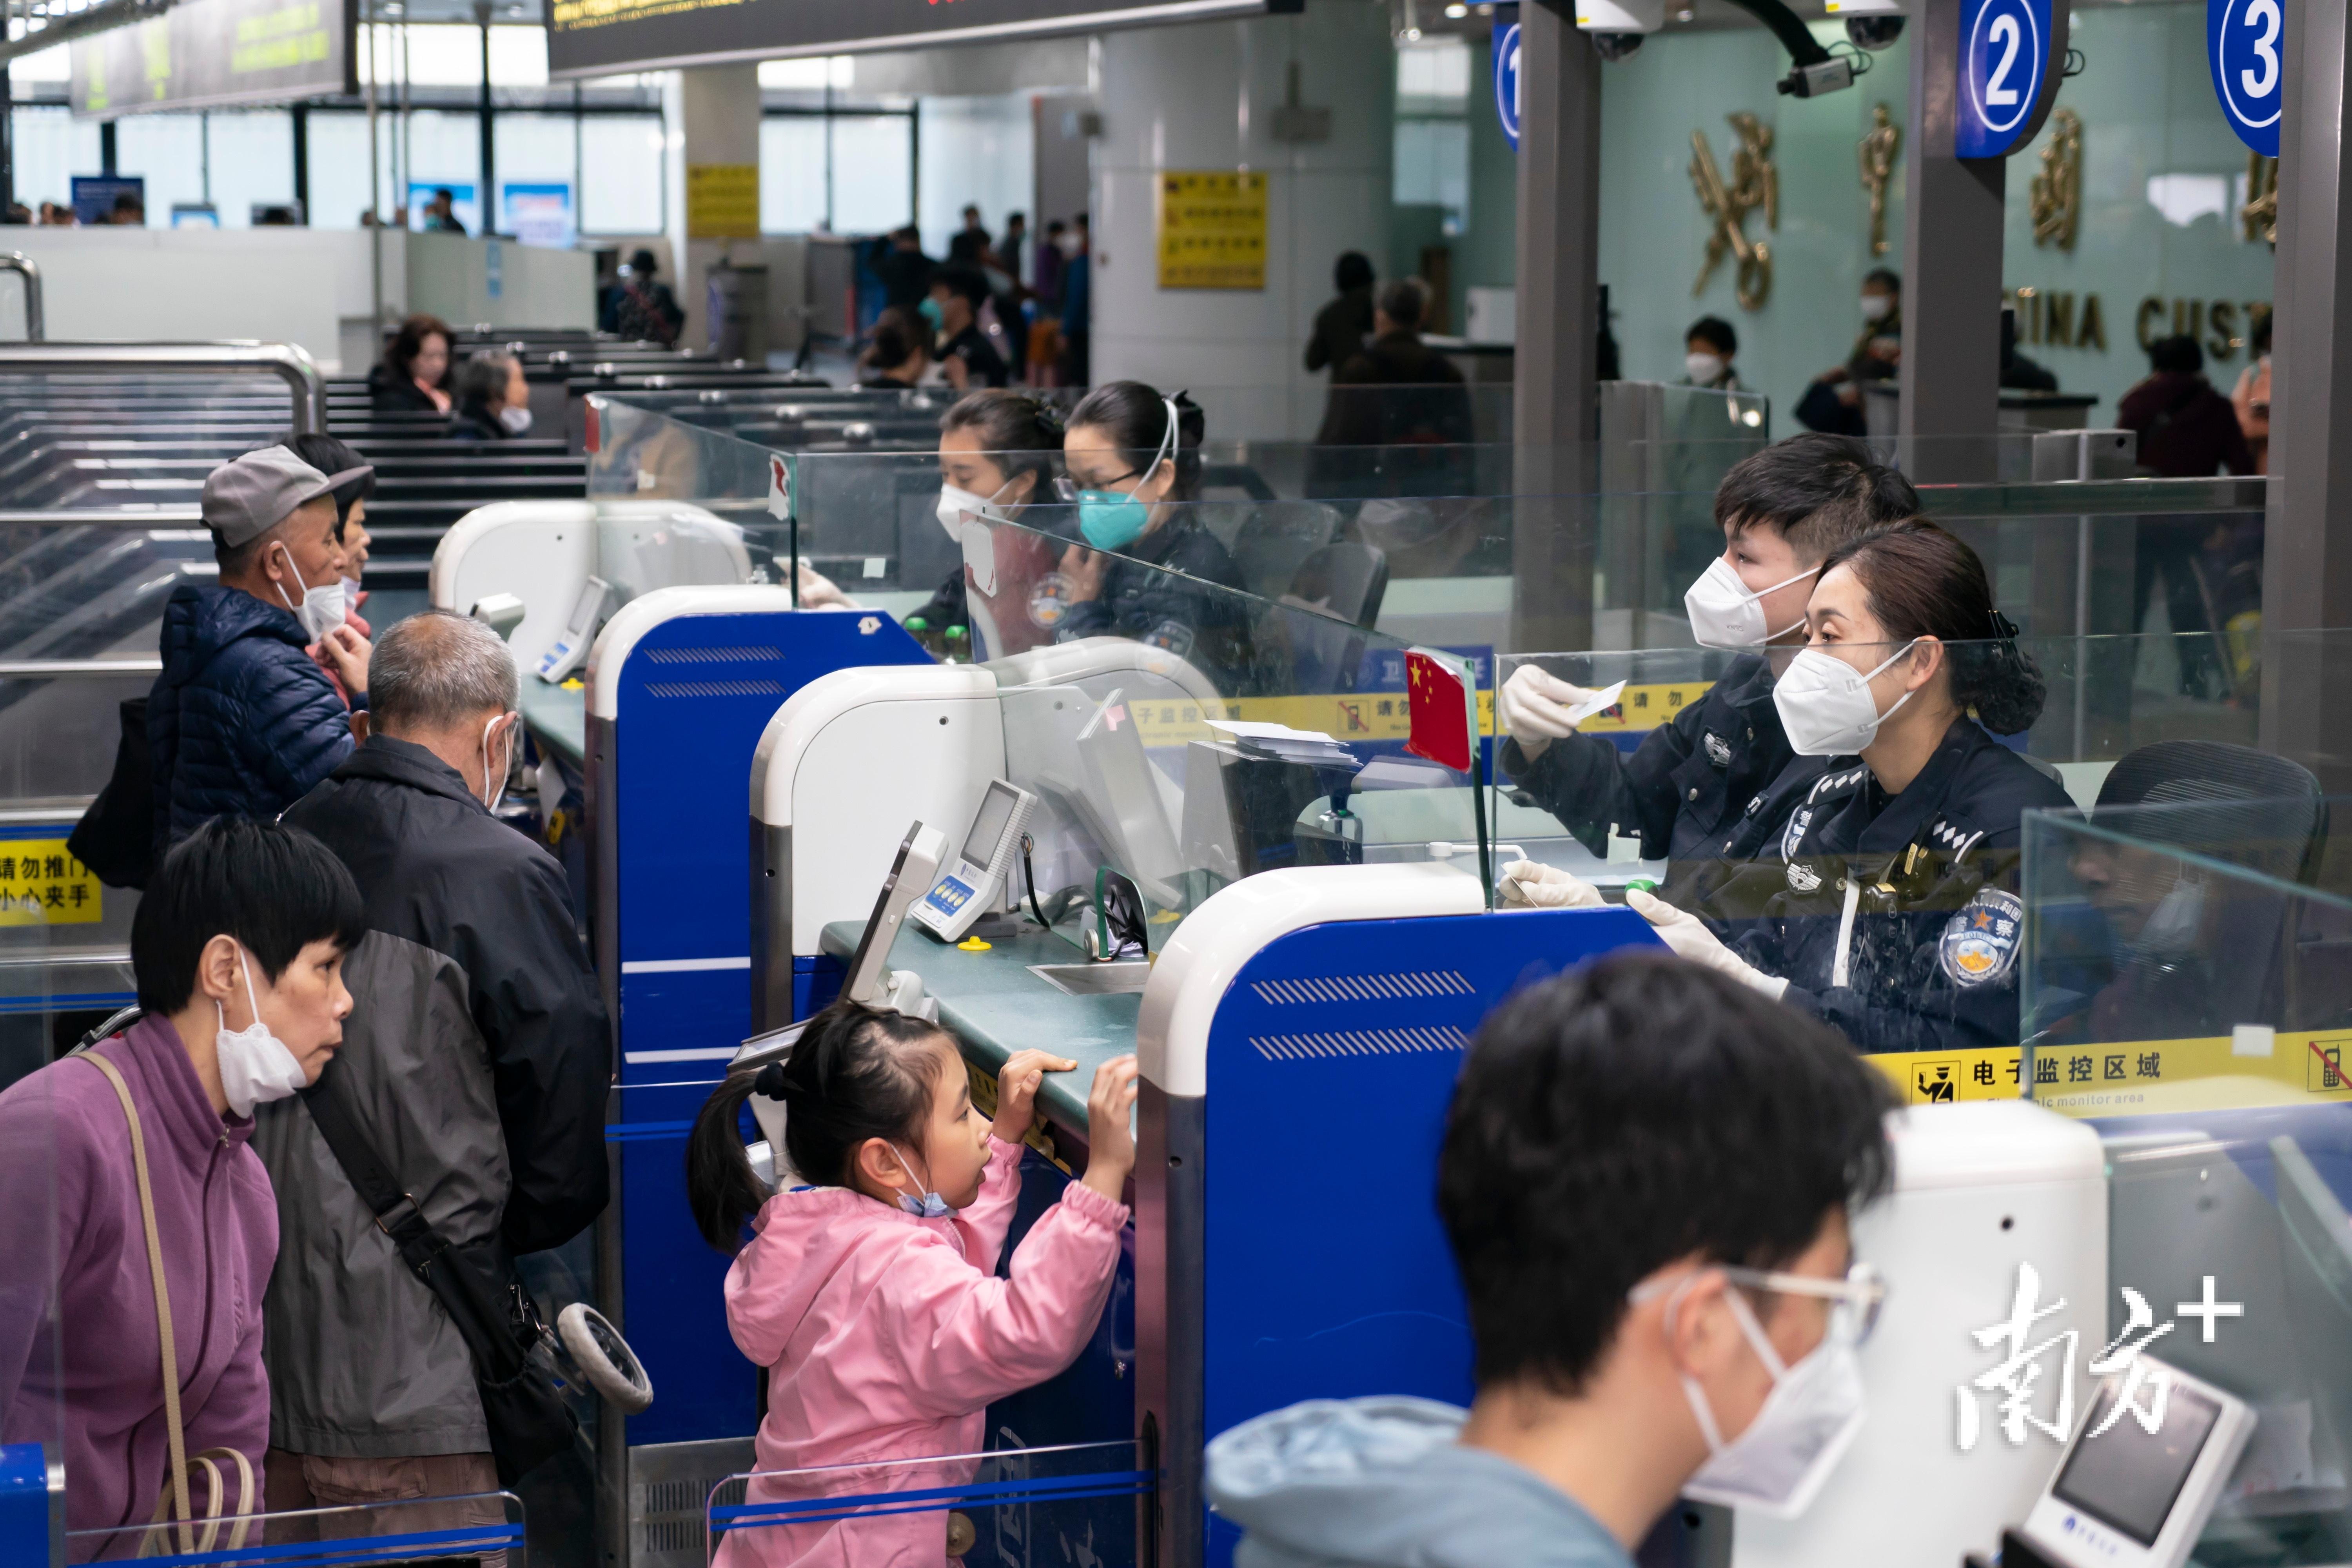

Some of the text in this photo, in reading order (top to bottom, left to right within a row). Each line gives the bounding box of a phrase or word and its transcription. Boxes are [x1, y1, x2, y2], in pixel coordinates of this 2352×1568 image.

[1986, 14, 2020, 105] 2
[2241, 0, 2281, 98] 3
[1509, 45, 1521, 117] 1
[0, 855, 89, 880] 请勿推门
[0, 884, 89, 911] 小心夹手
[1963, 931, 1994, 943] POLICE
[1974, 1052, 2160, 1085] 电子监控区域
[2057, 1094, 2111, 1107] monitor
[2115, 1093, 2144, 1104] area
